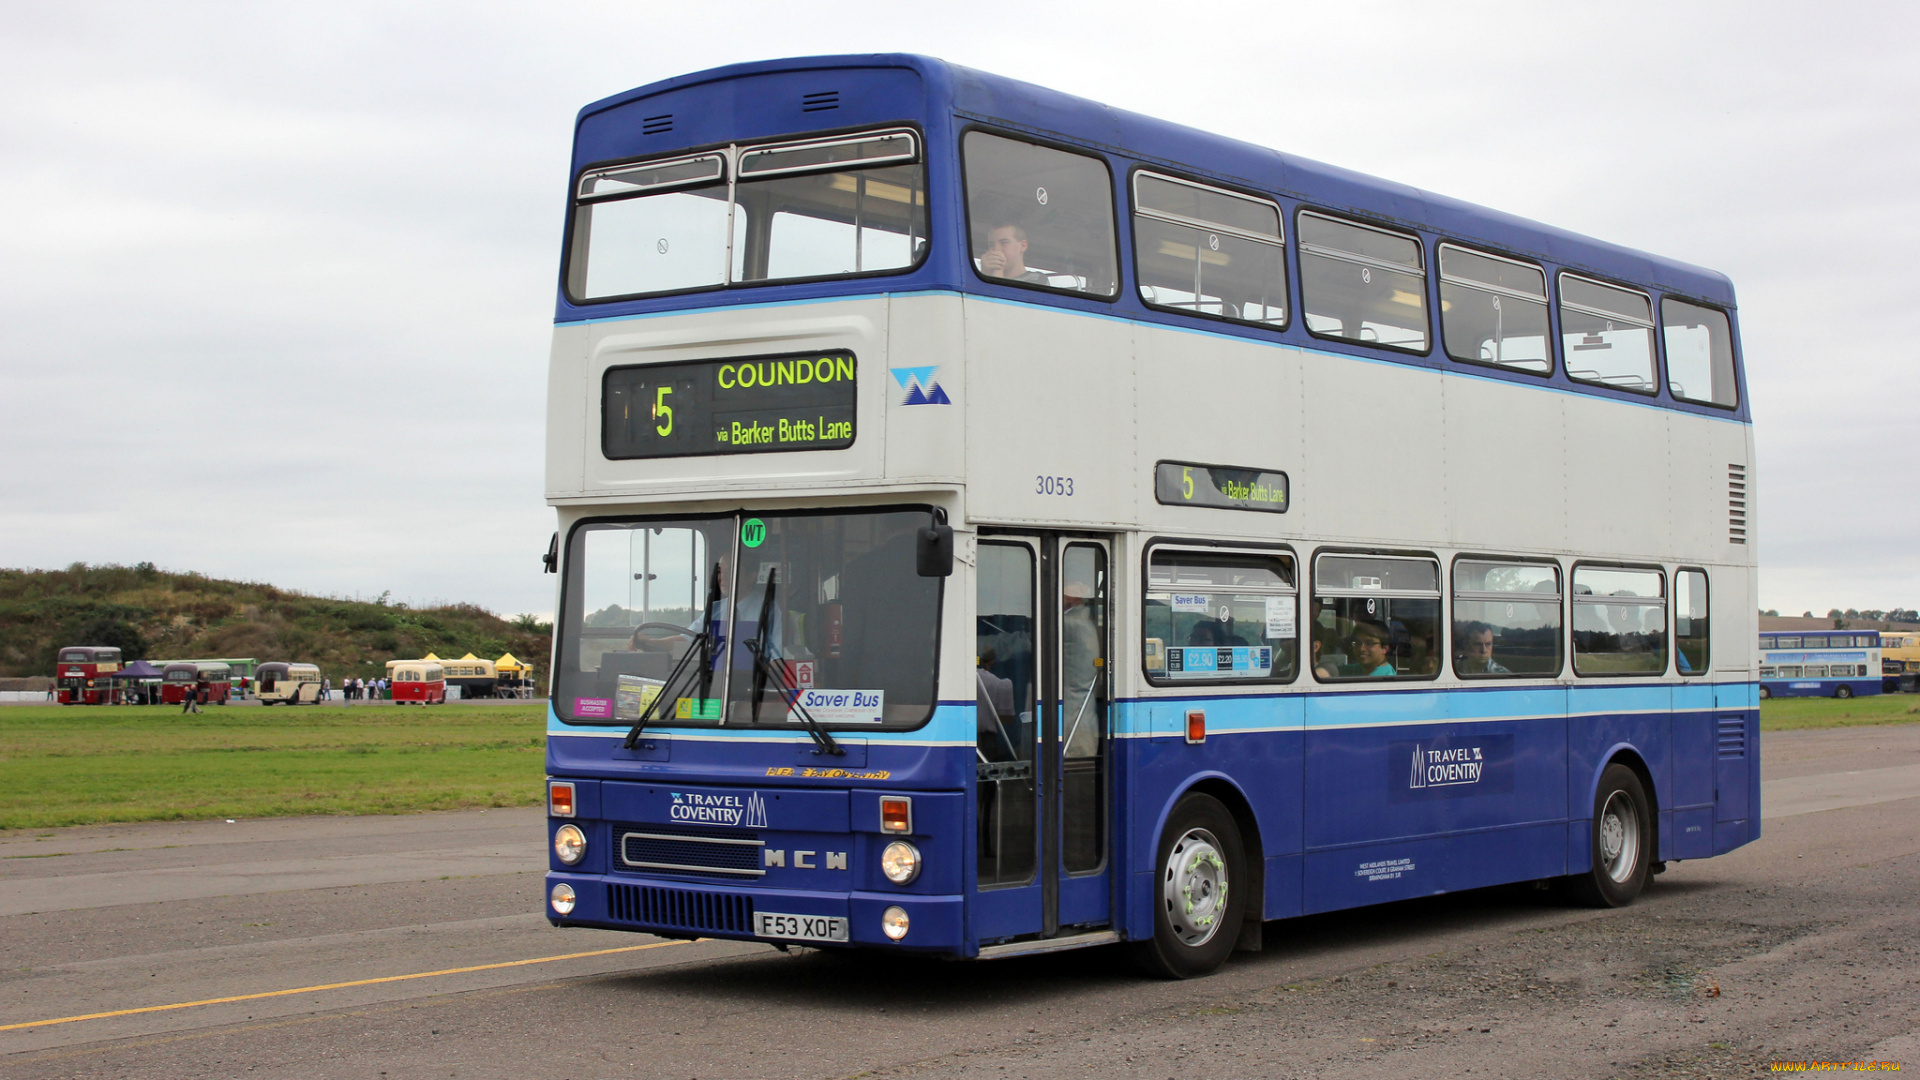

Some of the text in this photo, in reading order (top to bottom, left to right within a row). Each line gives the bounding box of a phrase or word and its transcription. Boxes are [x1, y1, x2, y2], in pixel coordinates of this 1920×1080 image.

[718, 356, 854, 389] COUNDON
[656, 386, 673, 437] 5
[716, 416, 852, 445] via Barker Butts Lane
[1035, 475, 1074, 497] 3053
[1183, 467, 1194, 499] 5
[1228, 481, 1249, 500] Barker
[1250, 482, 1267, 502] Butts
[1269, 484, 1284, 502] Lane
[745, 524, 763, 541] WT
[1175, 595, 1206, 605] Saver Bus
[1188, 653, 1213, 667] £2.90
[579, 699, 608, 707] BUSMASTER
[805, 691, 880, 707] Saver Bus
[1428, 748, 1471, 763] TRAVEL
[765, 767, 811, 777] PLEAE
[1428, 762, 1483, 783] COVENTRY
[686, 793, 744, 807] TRAVEL
[670, 805, 744, 826] COVENTRY
[762, 915, 839, 938] F53 XOF
